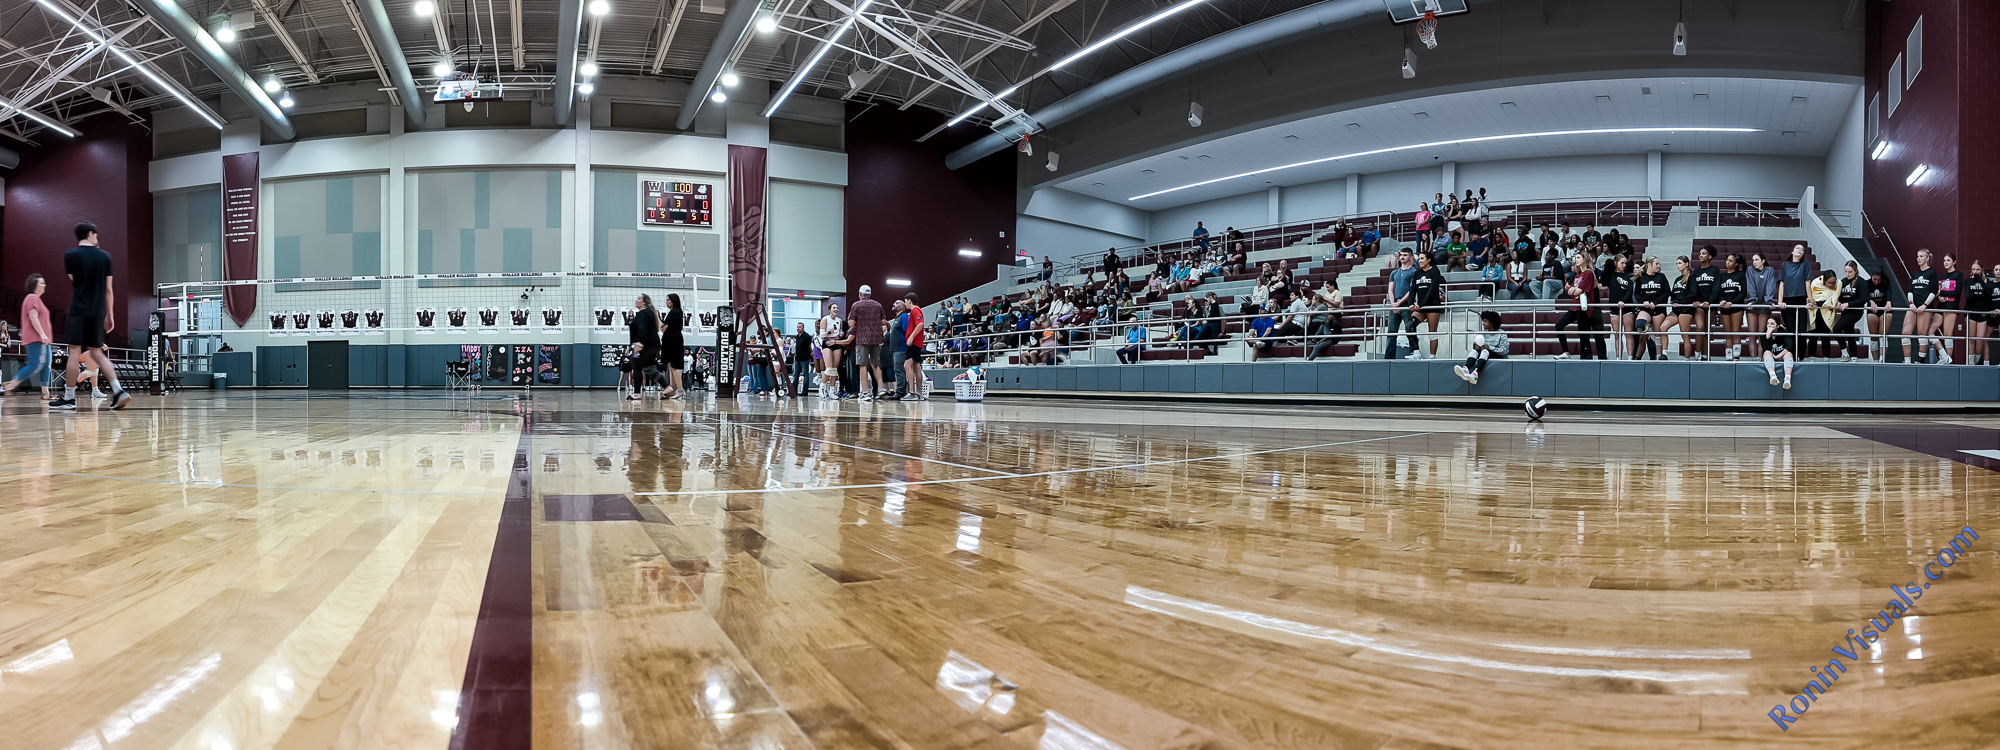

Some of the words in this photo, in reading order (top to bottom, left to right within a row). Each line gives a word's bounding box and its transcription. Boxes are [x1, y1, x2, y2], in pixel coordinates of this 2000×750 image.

[648, 182, 661, 191] W
[675, 183, 691, 193] 1:00
[656, 198, 662, 207] 0
[703, 201, 708, 209] 0
[720, 332, 729, 383] BULLDOGS
